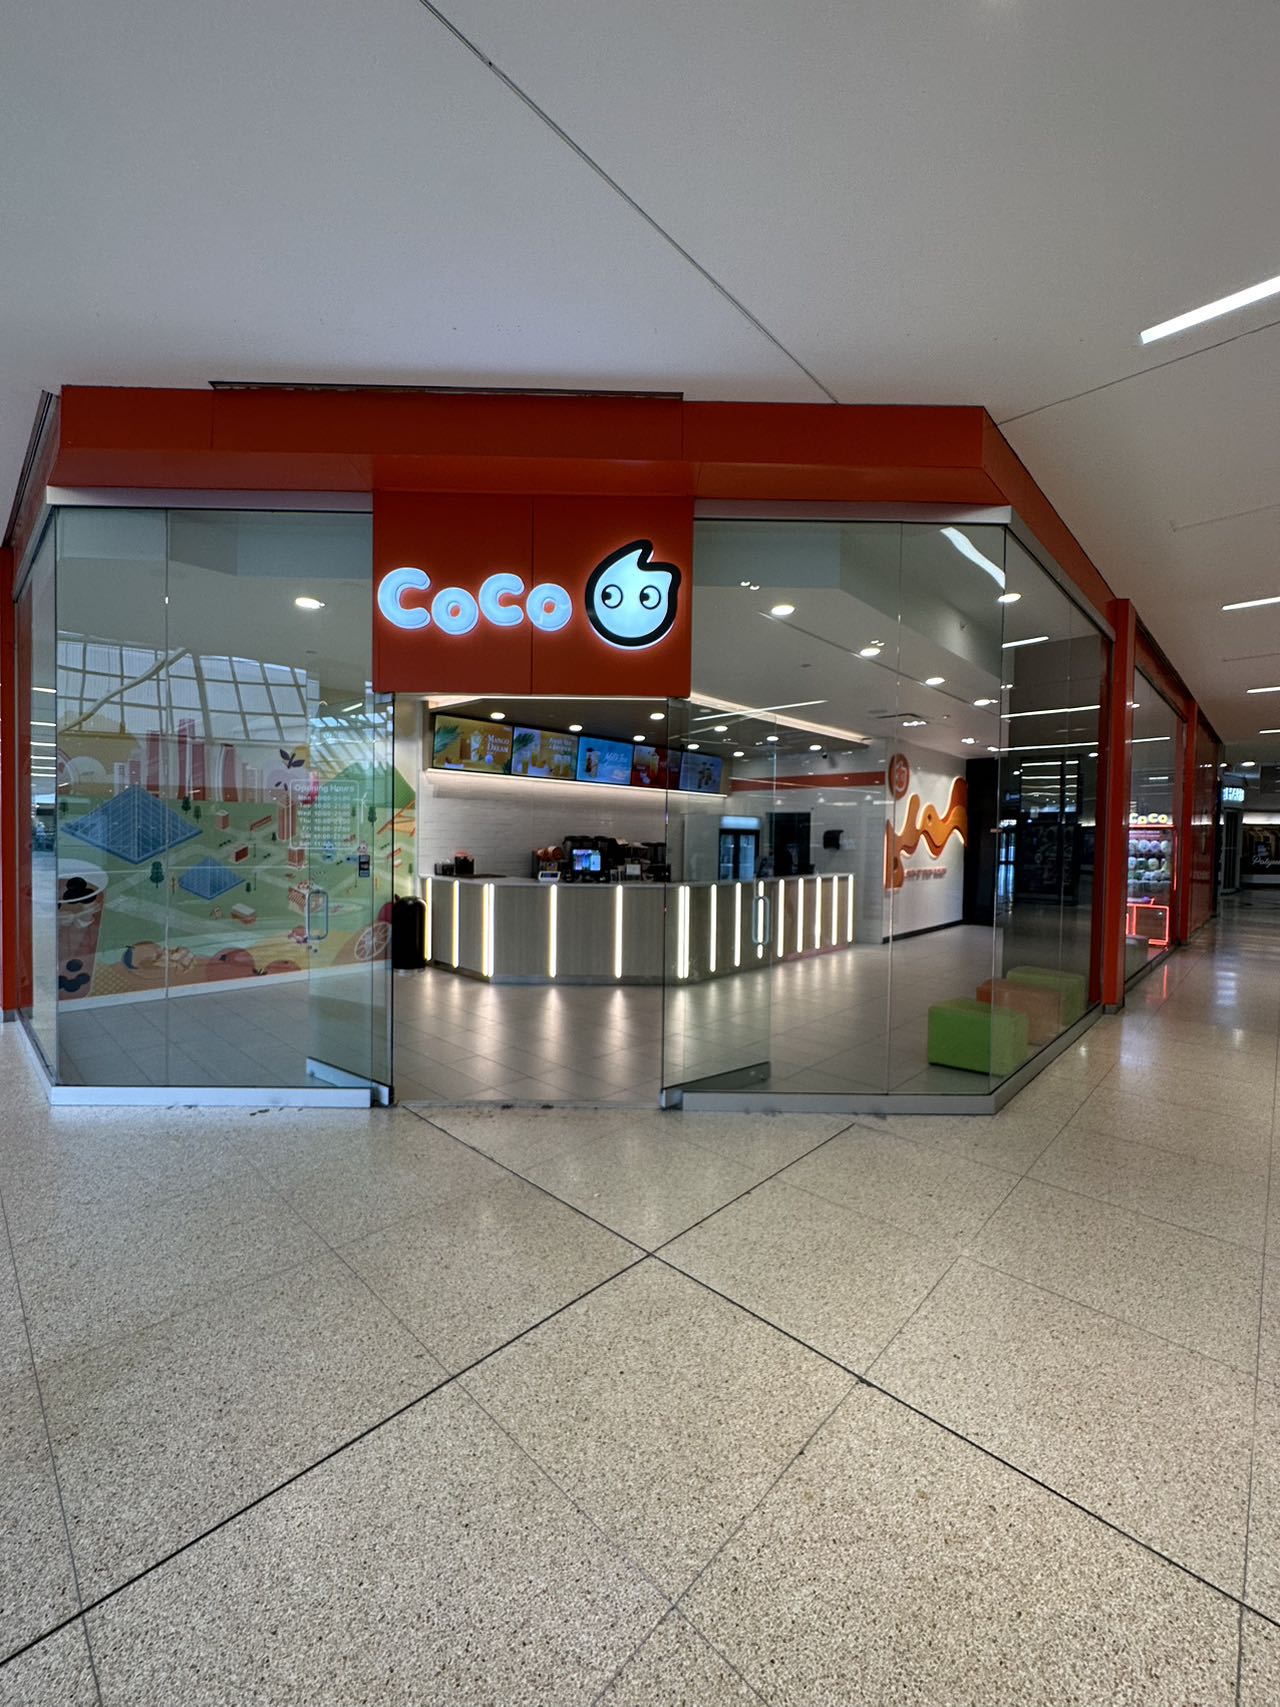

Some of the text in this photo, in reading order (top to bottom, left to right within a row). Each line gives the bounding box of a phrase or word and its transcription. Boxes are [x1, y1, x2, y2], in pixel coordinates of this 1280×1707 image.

[377, 567, 573, 635] CoCo
[488, 734, 510, 745] MANGO
[295, 784, 354, 793] Opening Hours
[1129, 813, 1168, 824] CoCo
